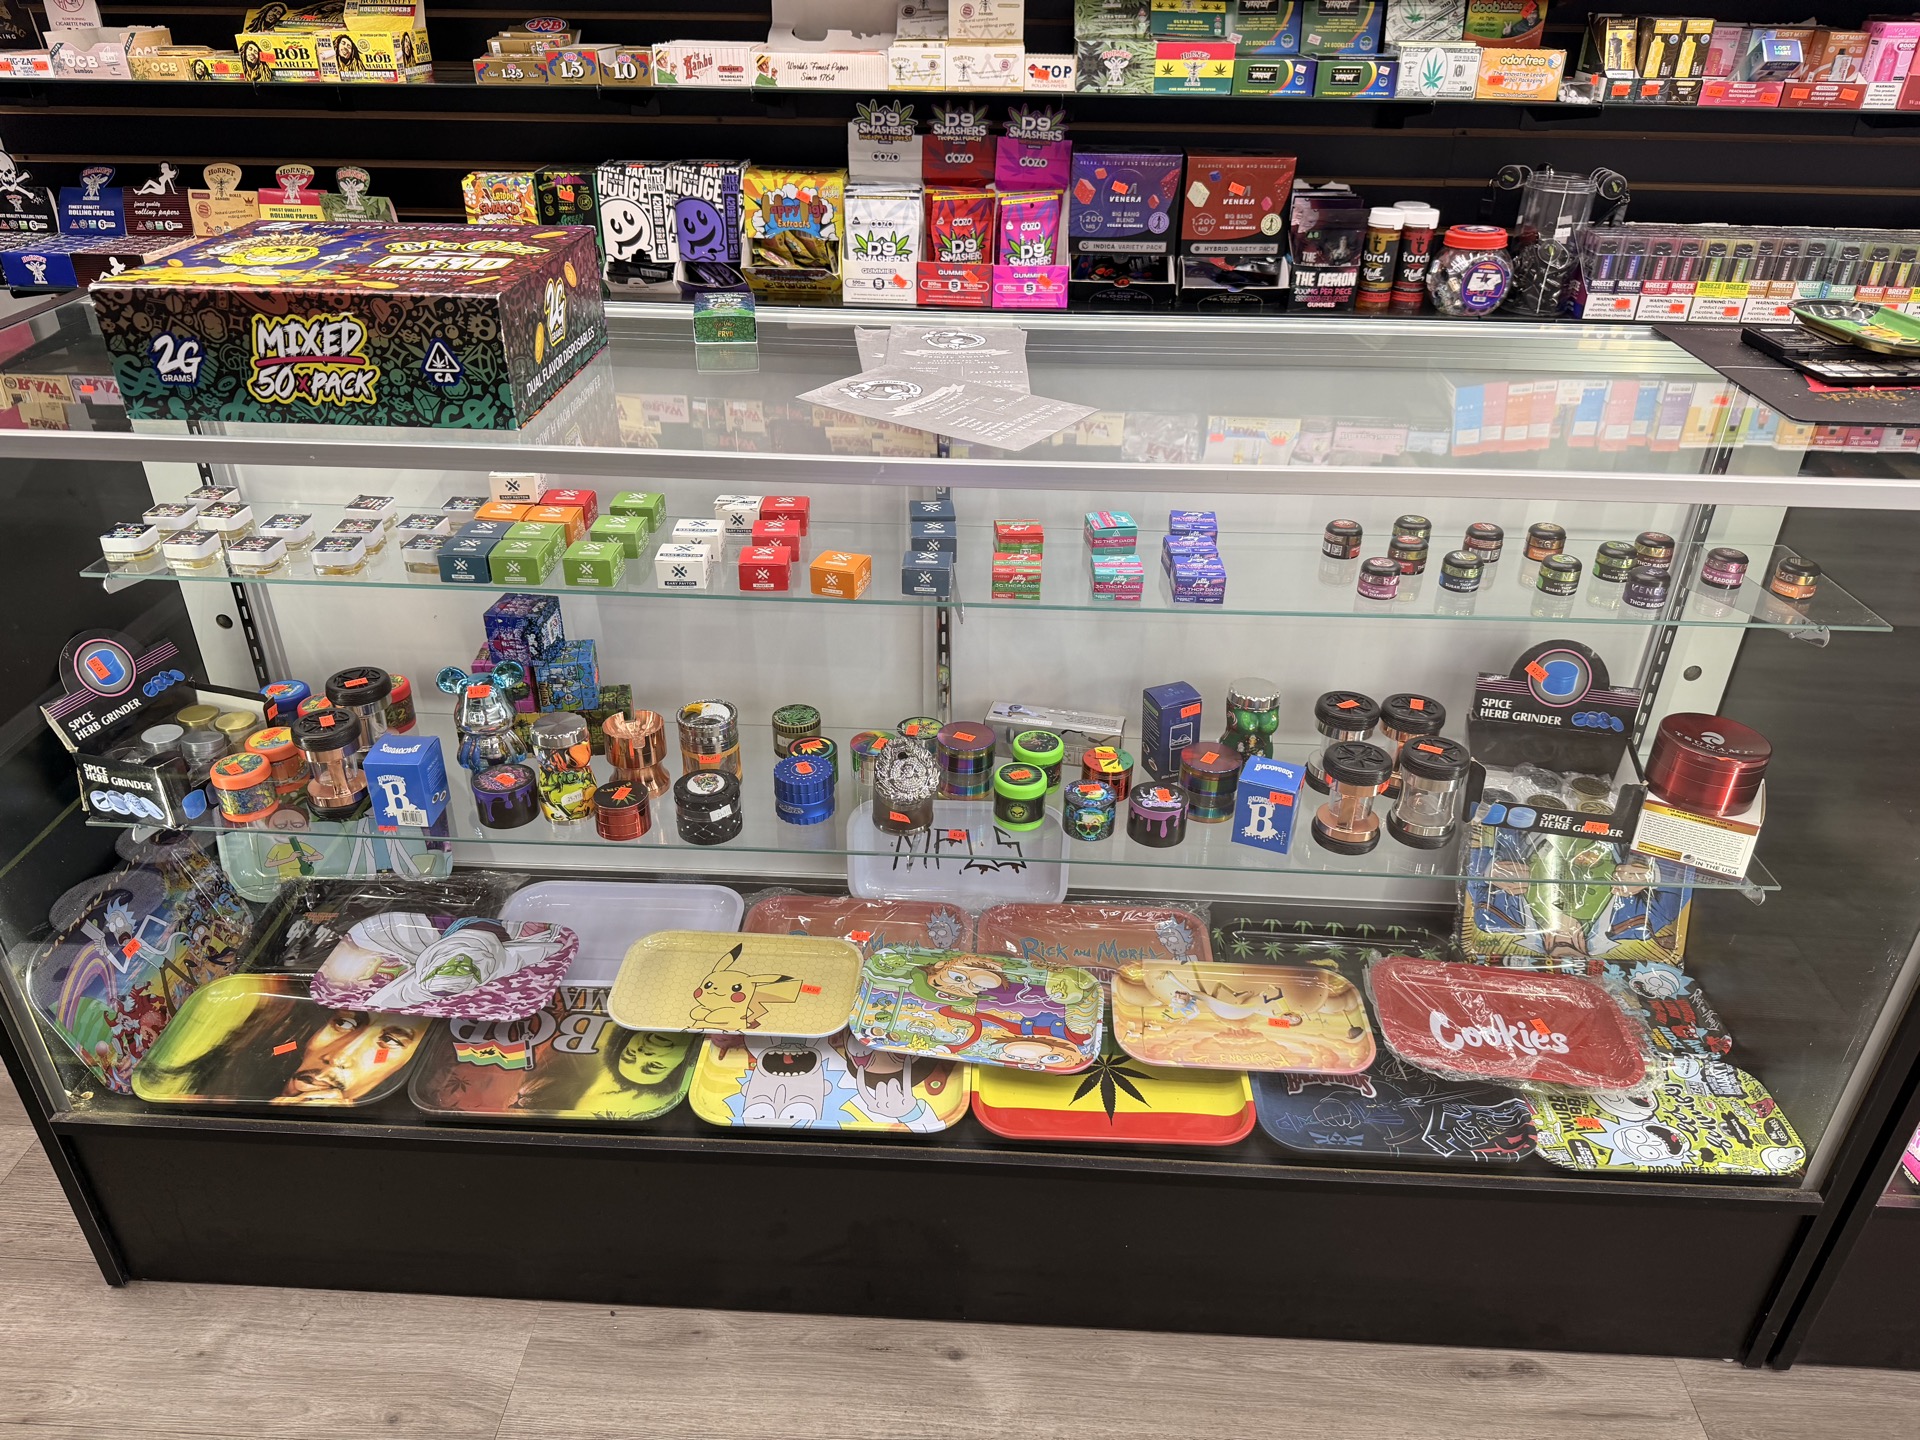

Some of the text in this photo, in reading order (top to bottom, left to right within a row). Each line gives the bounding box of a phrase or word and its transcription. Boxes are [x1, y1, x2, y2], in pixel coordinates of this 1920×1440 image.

[529, 20, 565, 31] JOB
[274, 46, 310, 60] BOB
[420, 41, 429, 53] BOB
[365, 54, 392, 63] BOB
[1501, 55, 1545, 65] odor free
[151, 62, 178, 72] OCB
[786, 62, 849, 72] World's Finest Paper
[1042, 65, 1072, 78] TOP
[801, 73, 818, 81] Since
[870, 112, 899, 126] D9
[945, 114, 974, 126] D9
[1022, 116, 1050, 130] D9
[858, 124, 912, 135] SMASHERS
[933, 124, 986, 136] SMASHERS
[1009, 126, 1062, 141] SMASHERS
[872, 151, 899, 162] dozo
[208, 165, 235, 176] HORNET
[279, 166, 311, 176] HORNET
[134, 209, 156, 217] rolling
[777, 220, 810, 228] Extracts
[867, 242, 896, 255] D9
[1021, 243, 1045, 259] D9
[368, 256, 514, 270] FRYD
[1364, 251, 1391, 264] torch
[1403, 252, 1430, 264] torch
[1296, 272, 1356, 286] THE DEMON
[256, 318, 364, 360] MIXED
[151, 334, 202, 382] 2G
[526, 326, 595, 396] DUAL FLAVOR DISPOSABLES
[162, 374, 192, 382] GRAMS
[435, 372, 454, 383] CA
[1110, 575, 1127, 584] jelly
[1193, 578, 1210, 587] jelly
[1781, 572, 1793, 582] 2G
[1482, 698, 1512, 709] SPICE
[68, 711, 96, 731] SPICE
[75, 698, 142, 740] HERB GRINDER
[1480, 709, 1561, 725] HERB GRINDER
[1674, 730, 1749, 754] TSUNAMI
[380, 743, 421, 754] BACKWOODS
[83, 763, 107, 775] SPICE
[1254, 763, 1294, 778] BACKWOODS
[86, 772, 153, 791] HERB GRINDER
[377, 774, 405, 786] BACKWOODS
[1541, 813, 1573, 824] SPICE
[1658, 848, 1681, 858] WARRANTY
[1705, 862, 1720, 871] THE
[1722, 866, 1737, 875] USA
[1430, 1009, 1570, 1055] Cookies
[1284, 1073, 1377, 1098] BACKWOODS
